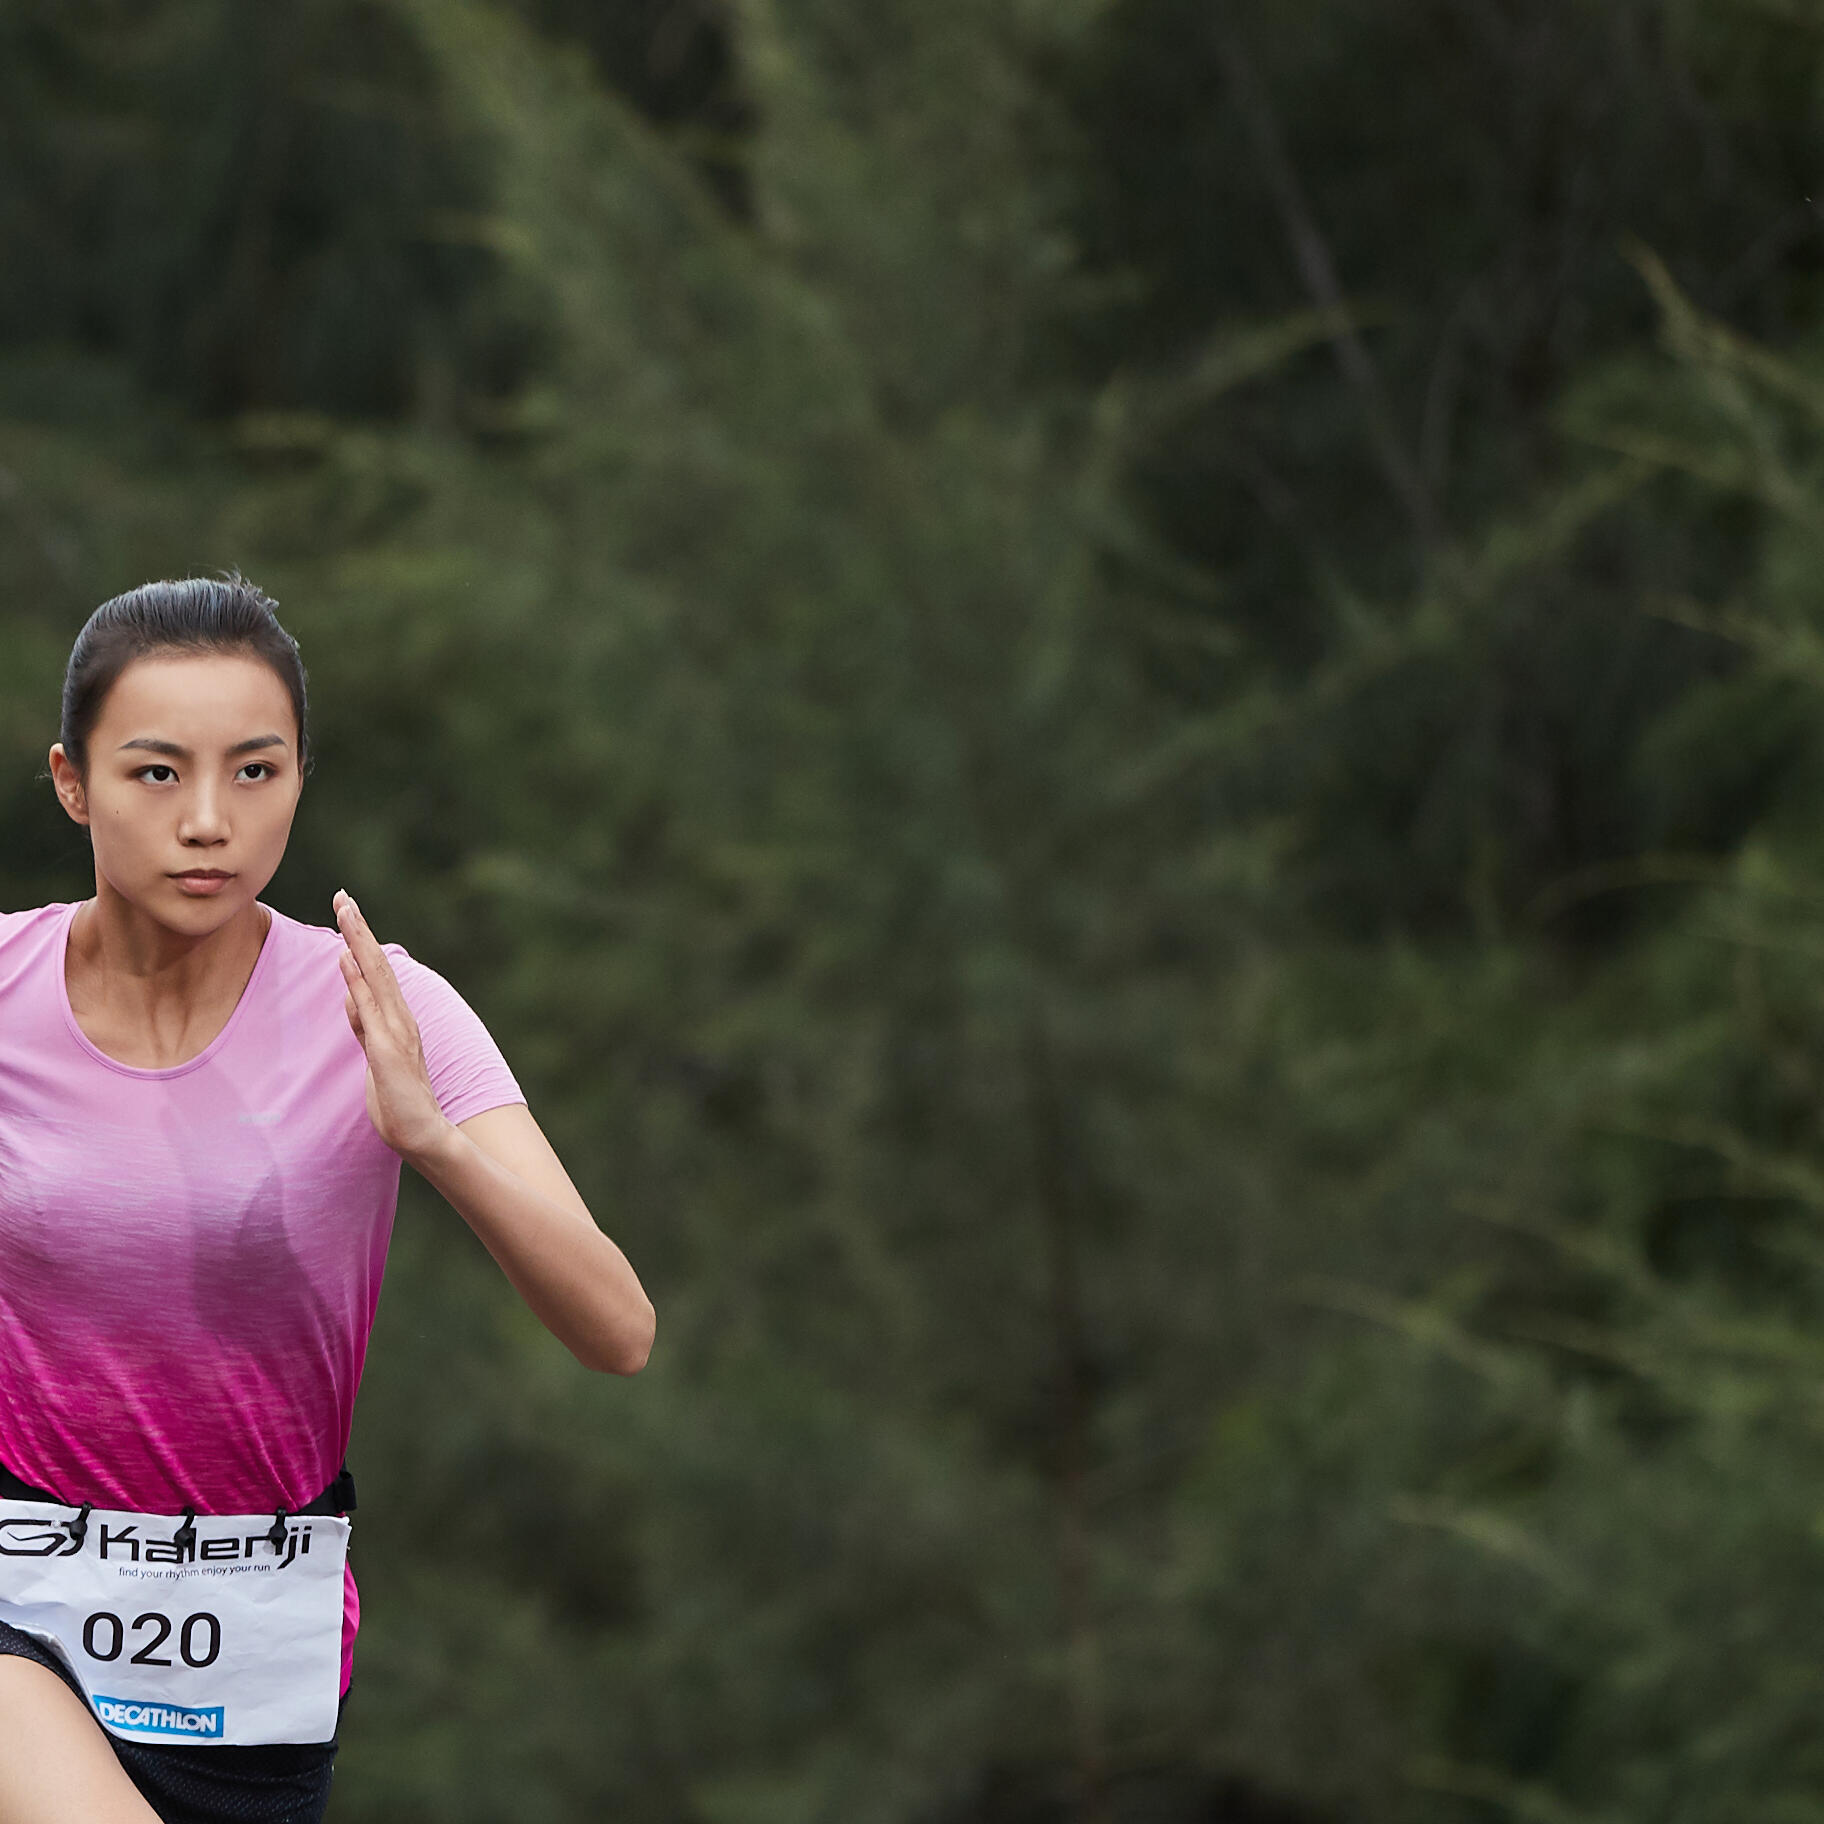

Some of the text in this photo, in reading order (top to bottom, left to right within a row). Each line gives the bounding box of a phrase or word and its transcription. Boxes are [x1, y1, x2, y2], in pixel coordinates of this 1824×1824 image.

[100, 1524, 312, 1569] Kalenji
[119, 1563, 271, 1581] find your rhythm enjoy your run
[83, 1611, 221, 1668] 020
[99, 1702, 217, 1732] DECATHLON
